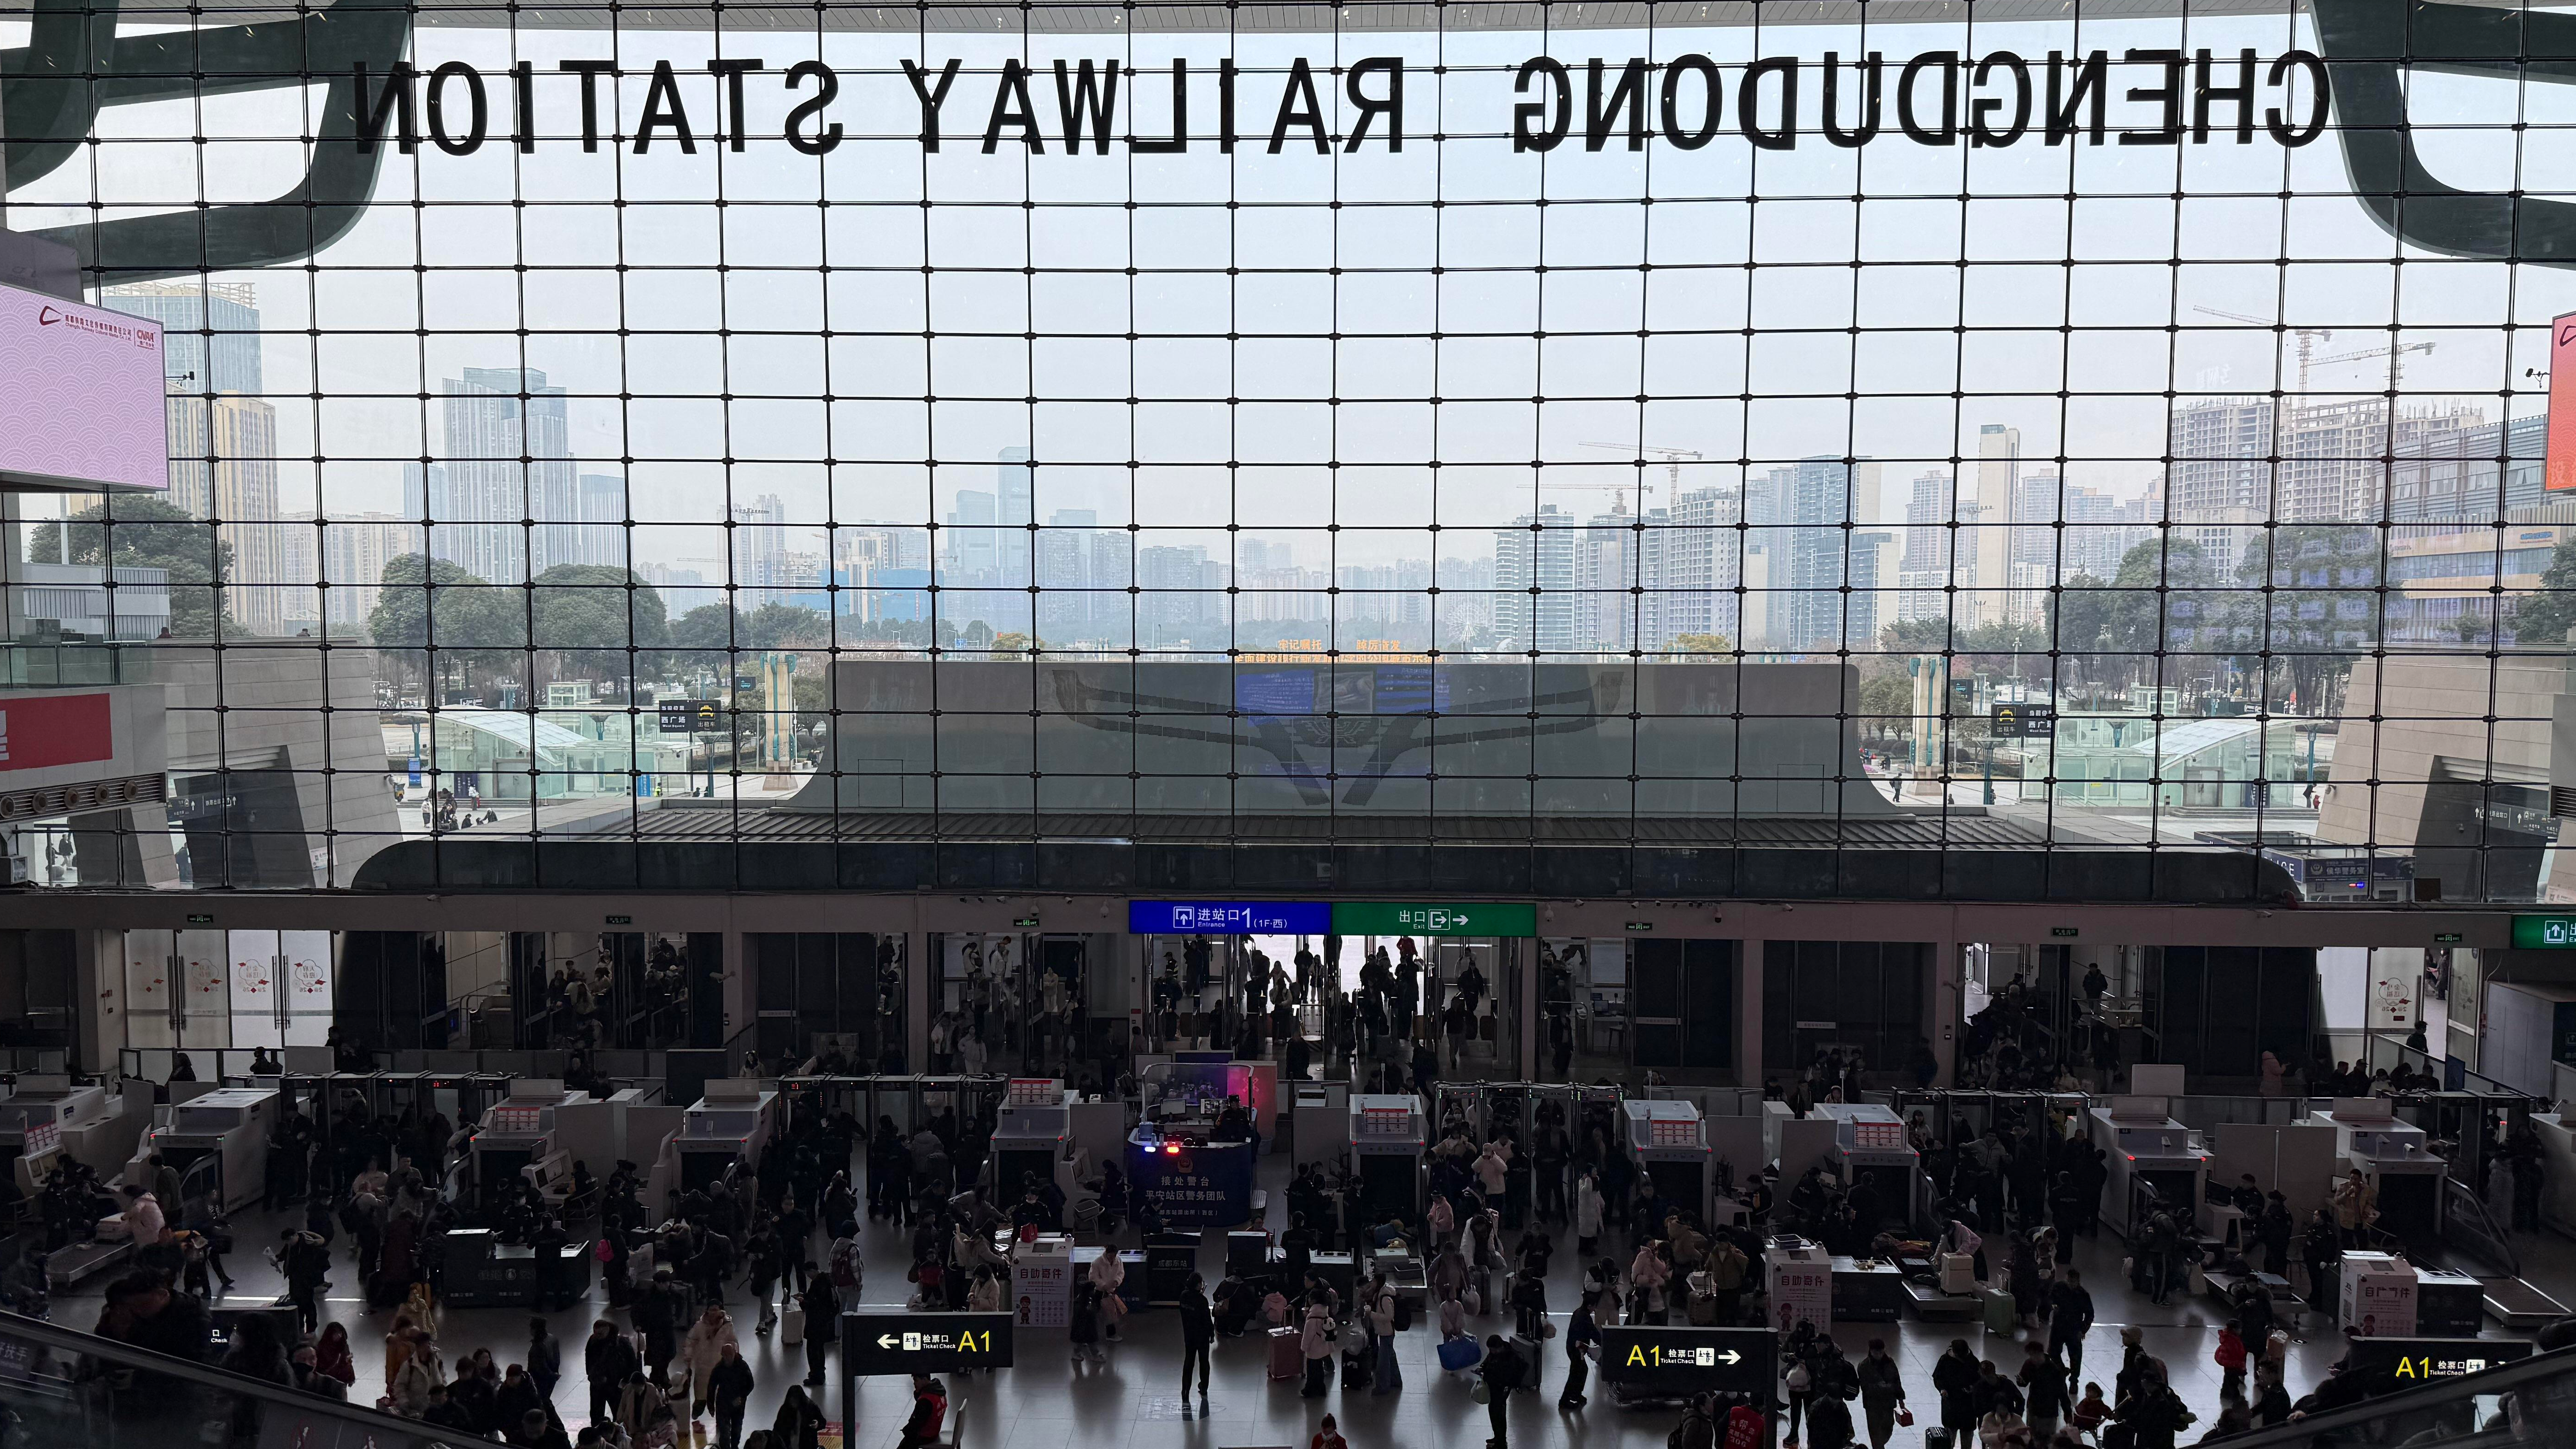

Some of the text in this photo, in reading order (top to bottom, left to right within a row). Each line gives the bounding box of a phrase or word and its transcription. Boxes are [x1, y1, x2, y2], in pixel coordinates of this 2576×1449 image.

[1399, 910, 1425, 923] 出口
[1161, 1176, 1210, 1187] 接处警台
[1145, 1190, 1226, 1201] 平安站区警务团队
[1021, 1268, 1062, 1279] 自助寄件
[1781, 1275, 1824, 1286] 自助寄件
[922, 1331, 990, 1352] 检票口 A1
[1626, 1345, 1695, 1367] A1 检票口
[2395, 1356, 2465, 1379] A1 检票口
